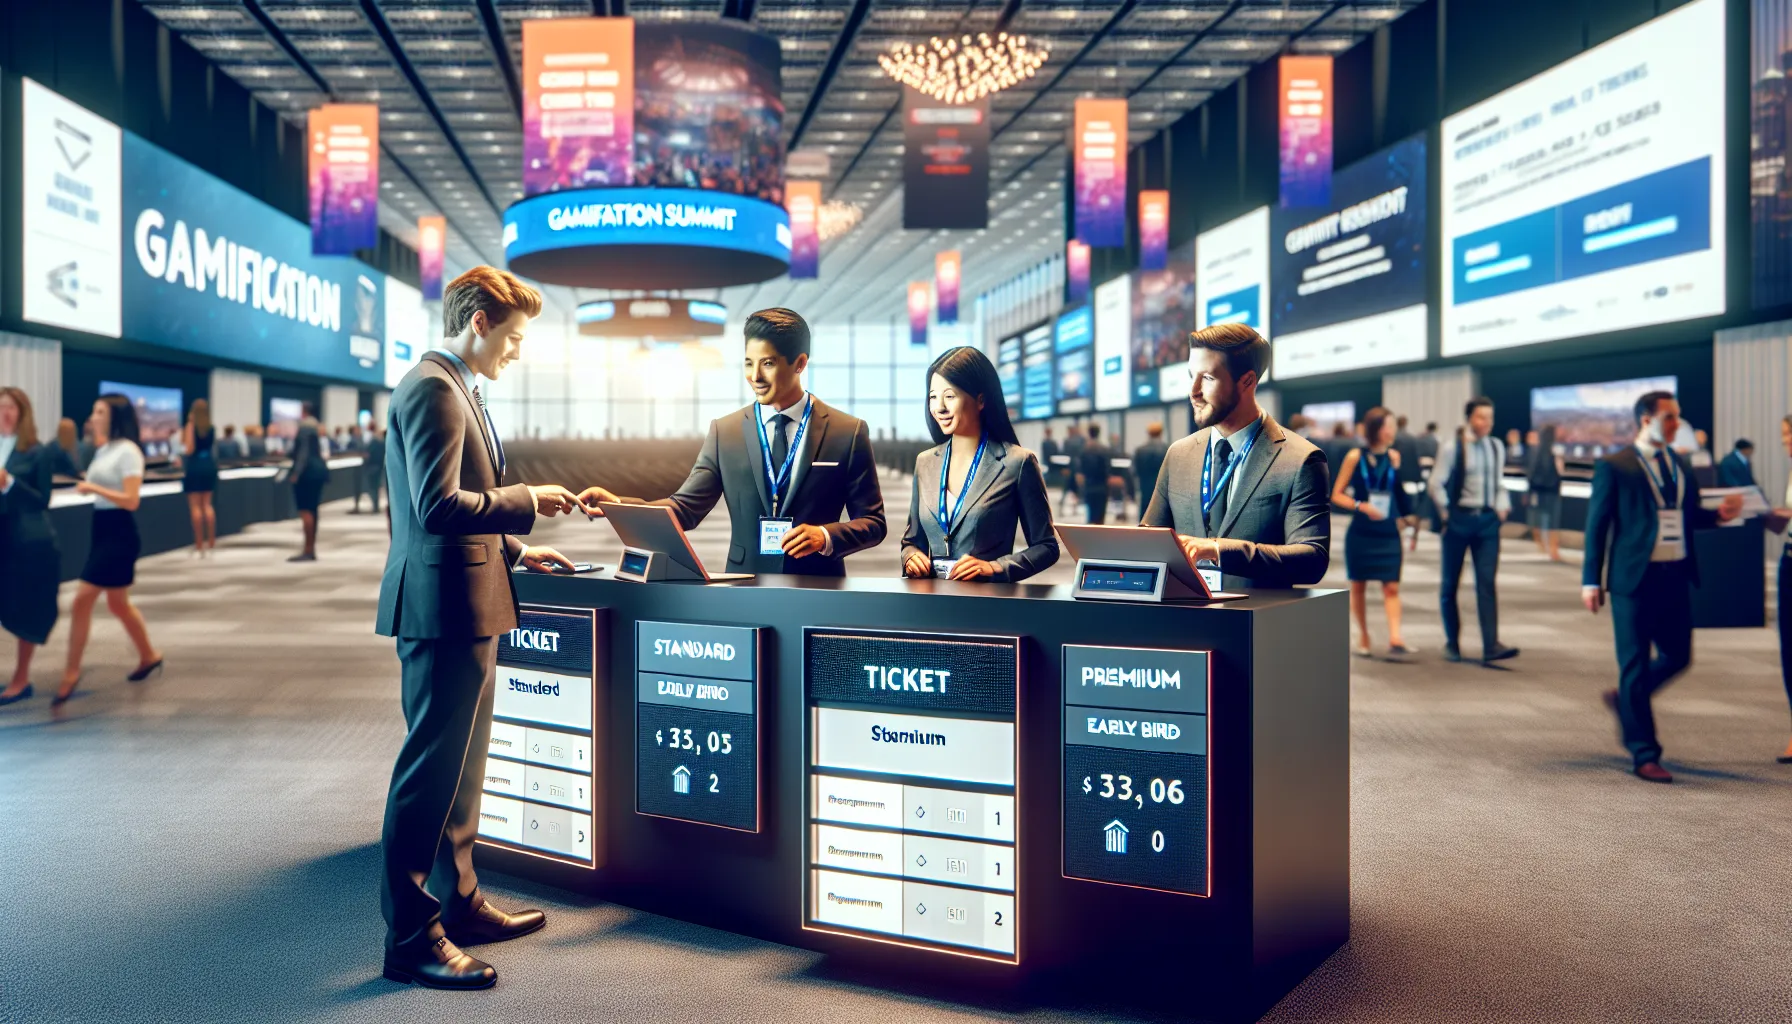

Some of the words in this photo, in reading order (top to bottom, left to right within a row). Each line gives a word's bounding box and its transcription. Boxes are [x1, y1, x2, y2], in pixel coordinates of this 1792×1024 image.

[664, 203, 737, 231] SUMMIT
[134, 208, 341, 333] GAMIFICATION
[654, 638, 736, 661] STANDARD
[863, 665, 951, 693] TICKET
[1087, 717, 1138, 737] EARLY
[1141, 721, 1181, 740] BIRD
[707, 731, 732, 754] 05
[709, 773, 720, 793] 2
[1099, 774, 1144, 810] 33,
[1150, 778, 1185, 805] 06
[994, 811, 1001, 826] 1
[1151, 830, 1165, 853] 0
[994, 862, 1001, 876] 1
[993, 911, 1004, 926] 2
